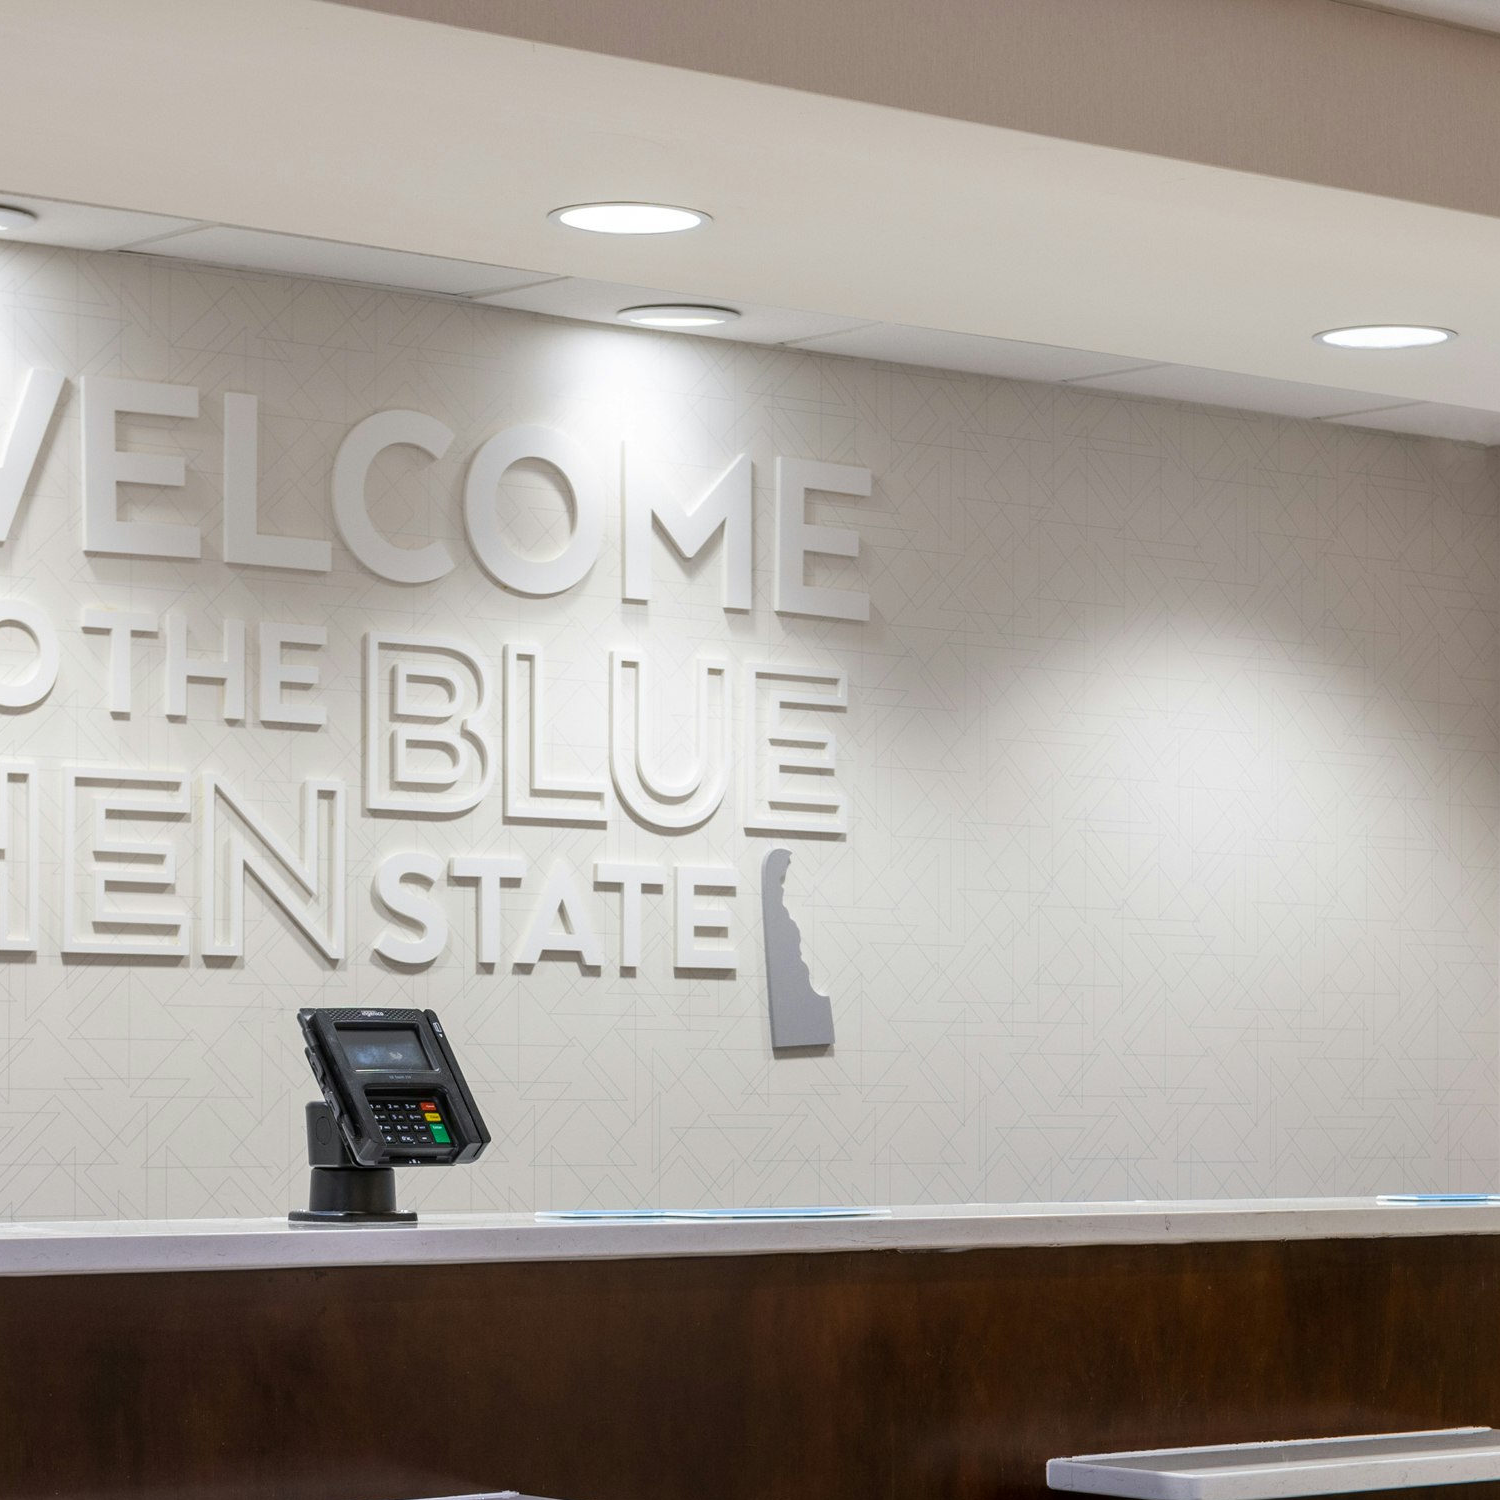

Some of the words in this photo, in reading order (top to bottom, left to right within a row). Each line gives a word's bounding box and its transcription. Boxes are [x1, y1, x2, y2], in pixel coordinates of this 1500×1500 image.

[80, 606, 328, 729] THE
[362, 630, 849, 840] BLUE
[372, 850, 740, 980] STATE
